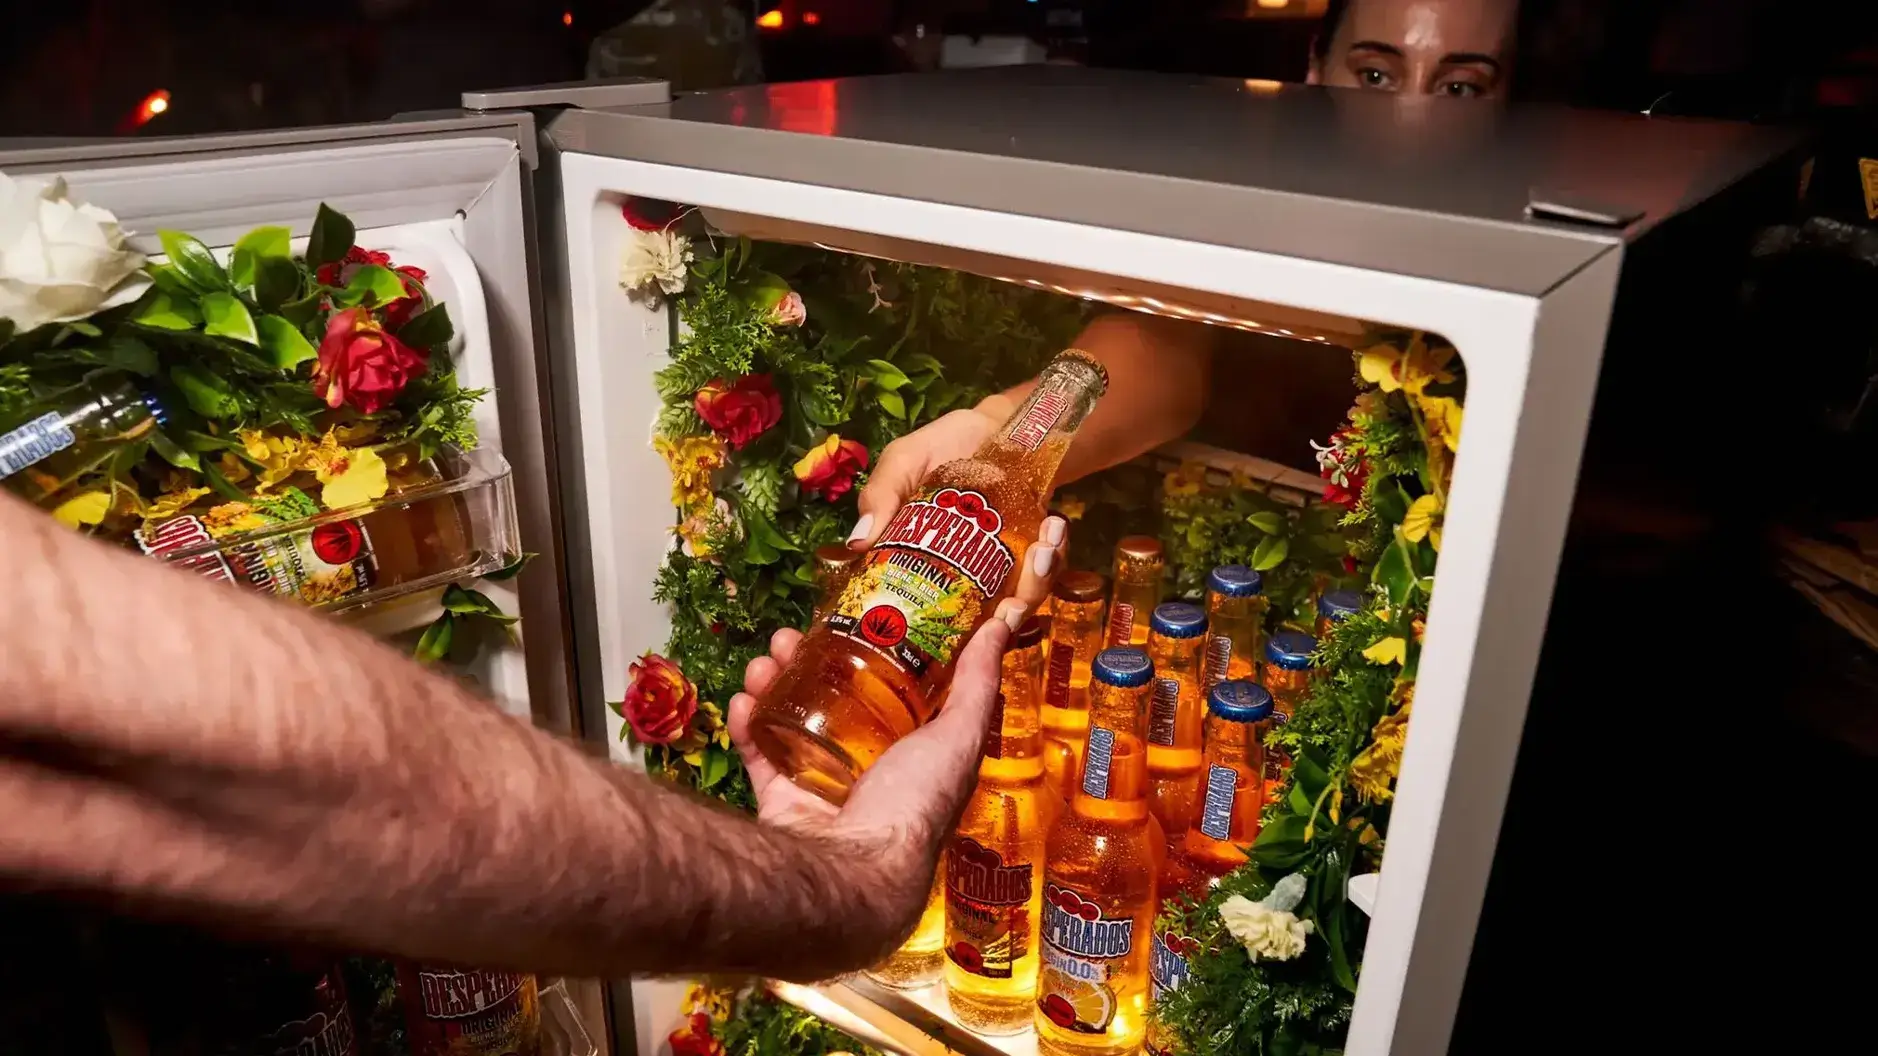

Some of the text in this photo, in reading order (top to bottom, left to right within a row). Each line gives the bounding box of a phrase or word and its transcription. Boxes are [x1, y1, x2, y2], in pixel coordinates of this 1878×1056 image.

[876, 501, 1015, 598] DESPERADOS
[888, 551, 957, 595] ORIGINAL
[886, 582, 925, 609] TEQUILA
[1202, 764, 1237, 840] DESPERADOS
